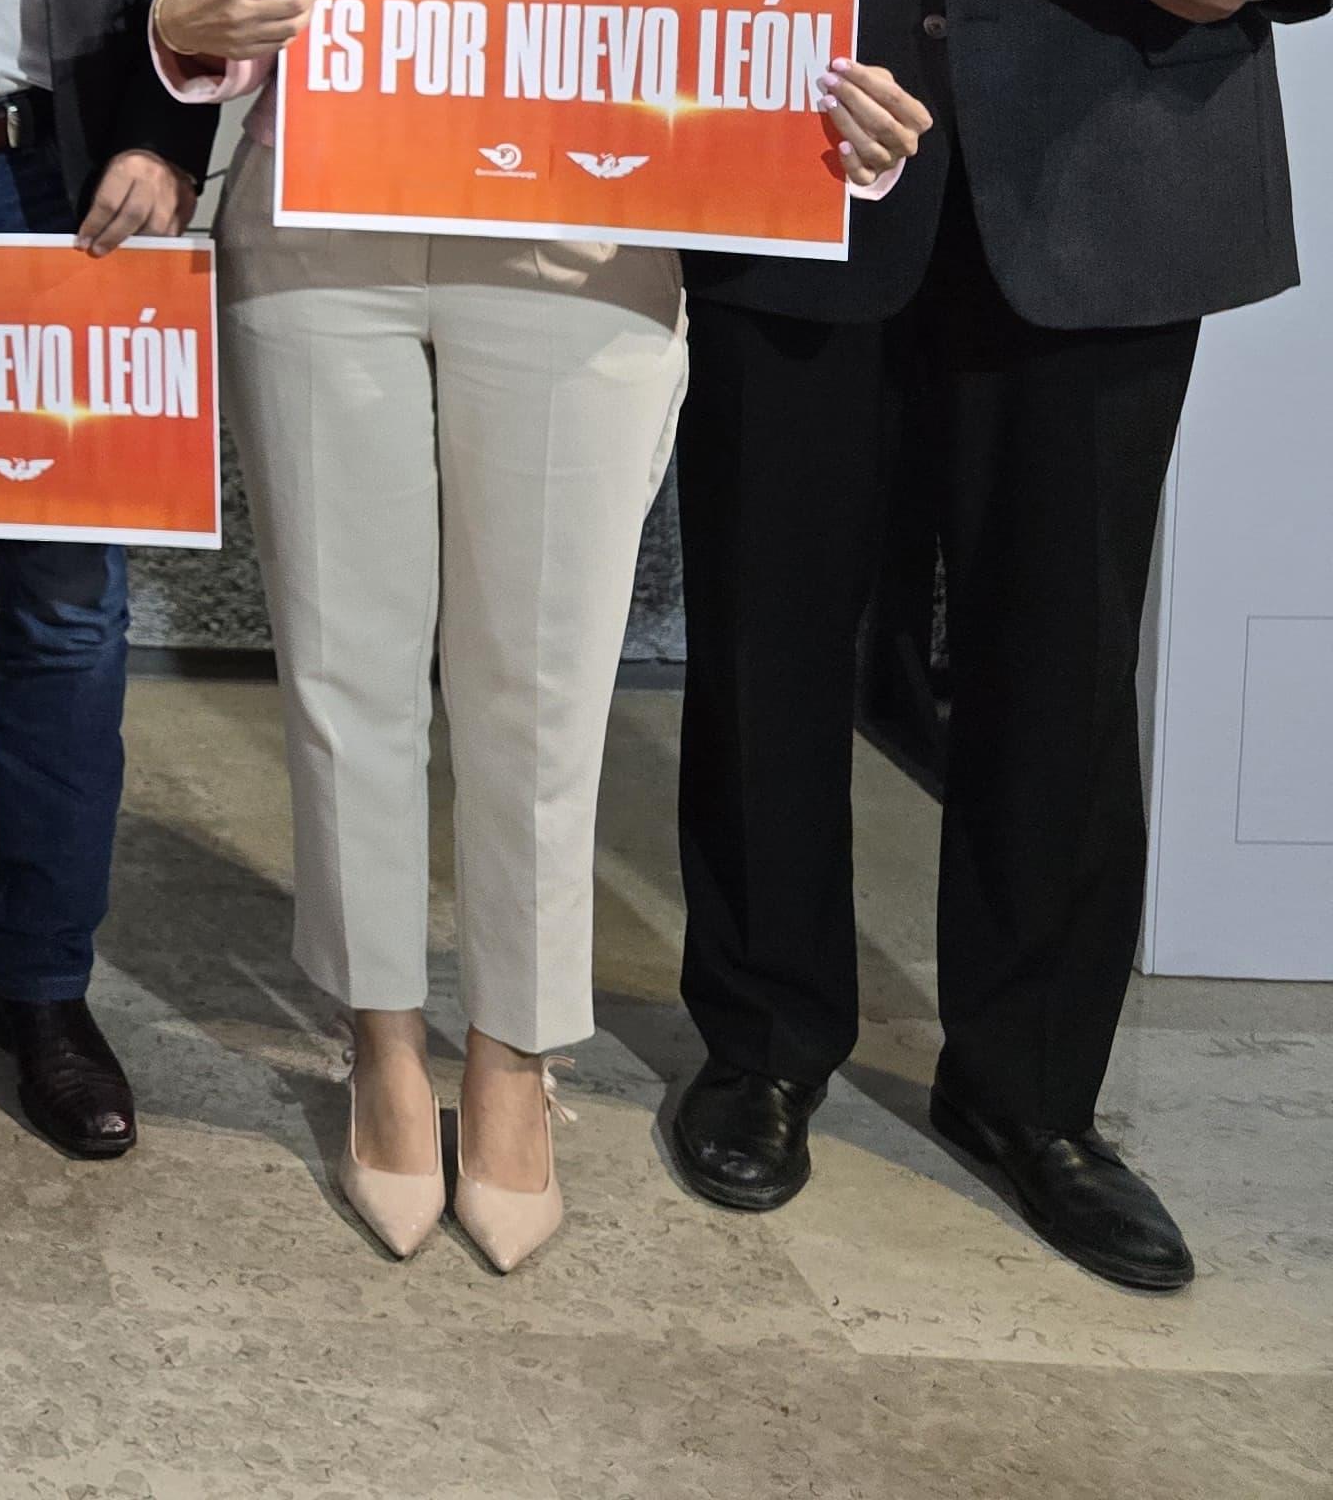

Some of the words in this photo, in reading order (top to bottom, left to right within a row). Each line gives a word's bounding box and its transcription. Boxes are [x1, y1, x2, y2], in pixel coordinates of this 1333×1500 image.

[380, 0, 487, 97] POR
[504, 2, 678, 103] NUEVO
[88, 308, 198, 418] LEÓN
